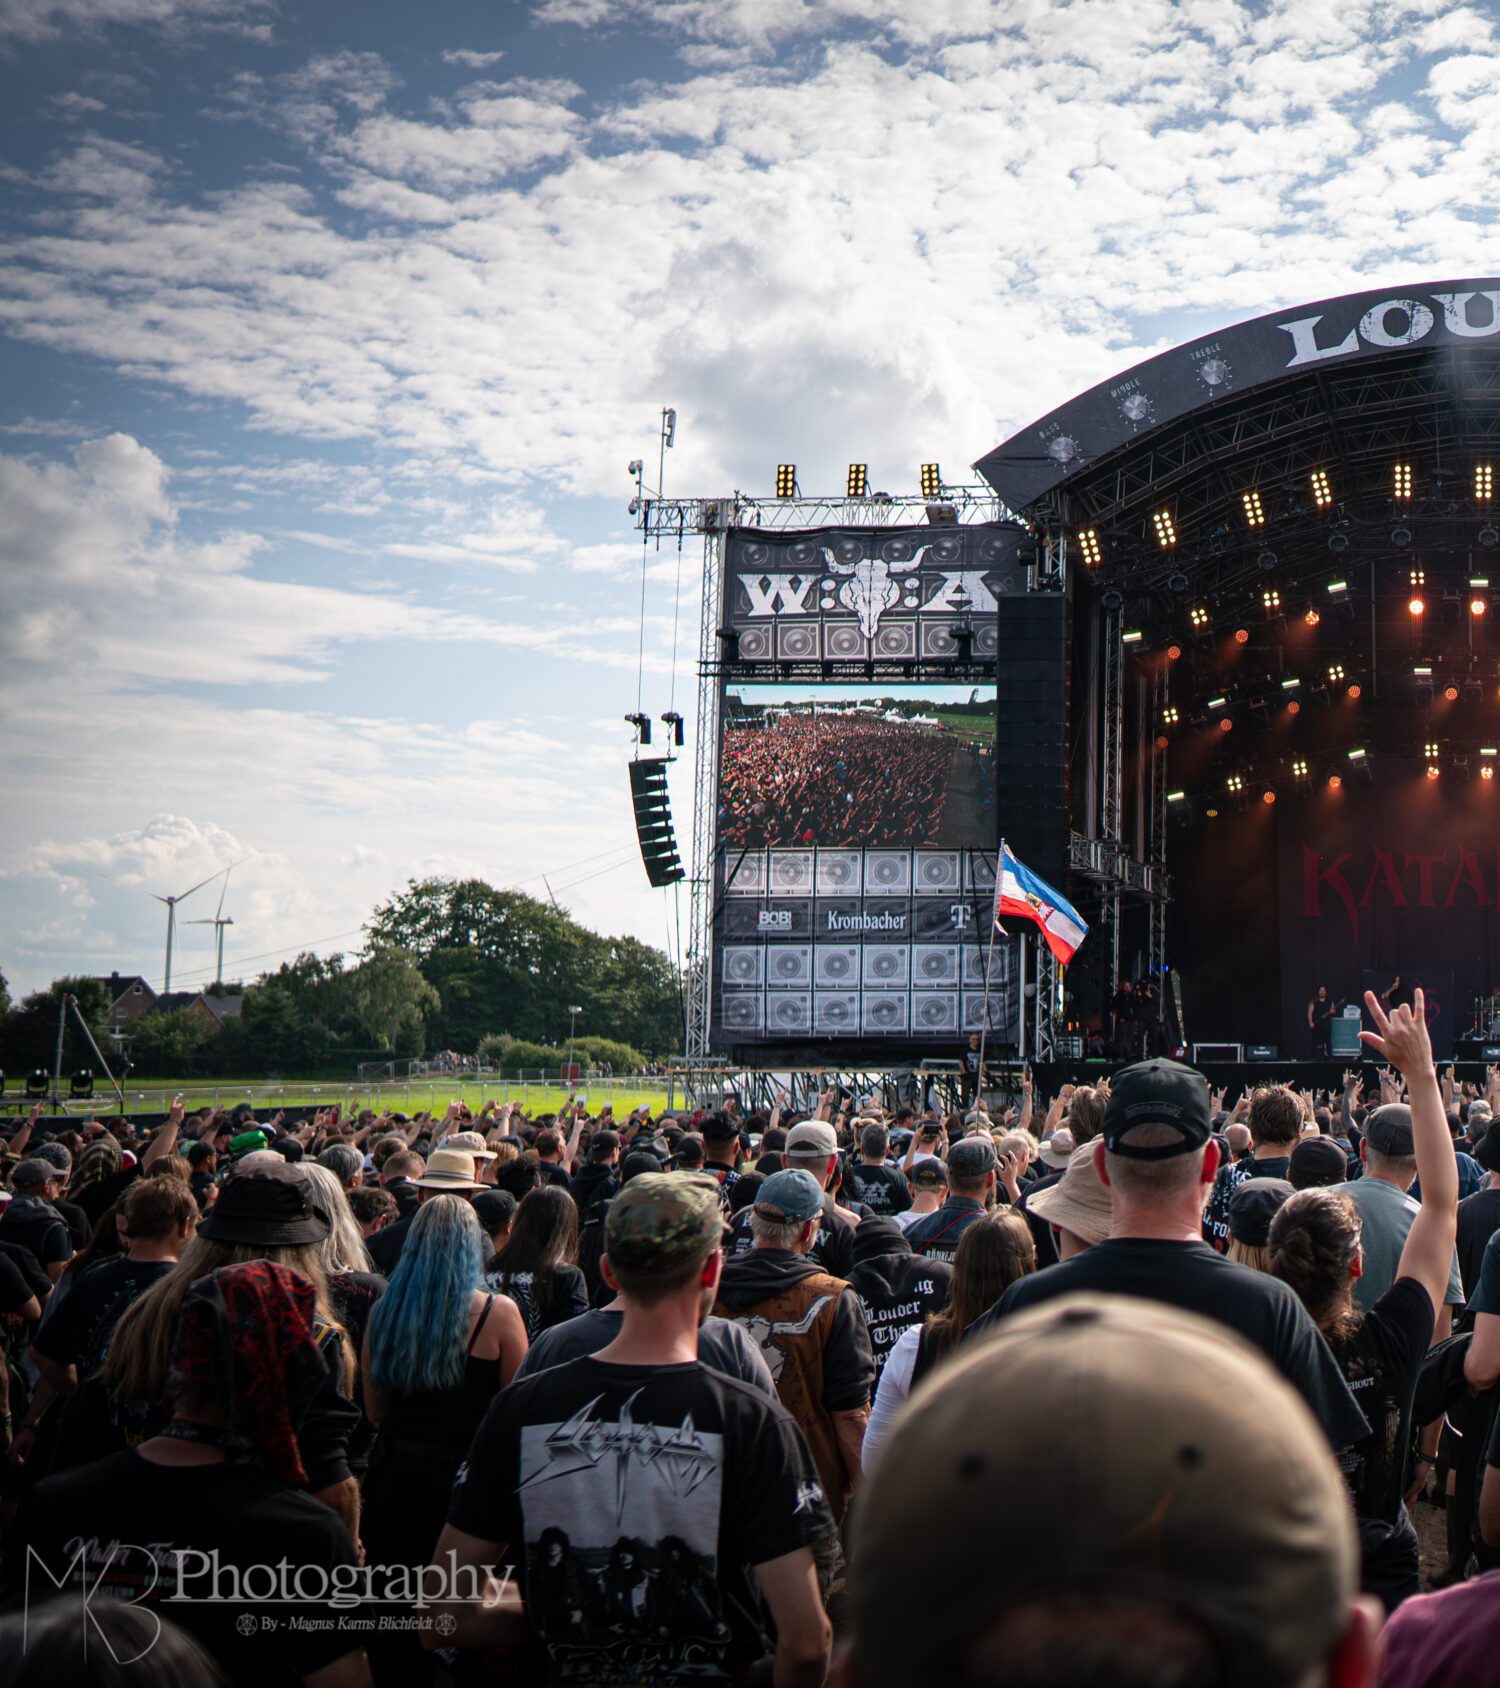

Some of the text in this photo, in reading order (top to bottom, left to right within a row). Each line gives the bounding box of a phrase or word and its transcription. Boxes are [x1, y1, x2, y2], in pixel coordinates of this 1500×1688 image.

[1190, 342, 1222, 361] TREBLE
[1110, 377, 1142, 398] MIDDLE
[758, 910, 792, 925] BOB!
[827, 910, 907, 930] Krombacher
[865, 1301, 921, 1326] Louder
[872, 1323, 913, 1345] Tha
